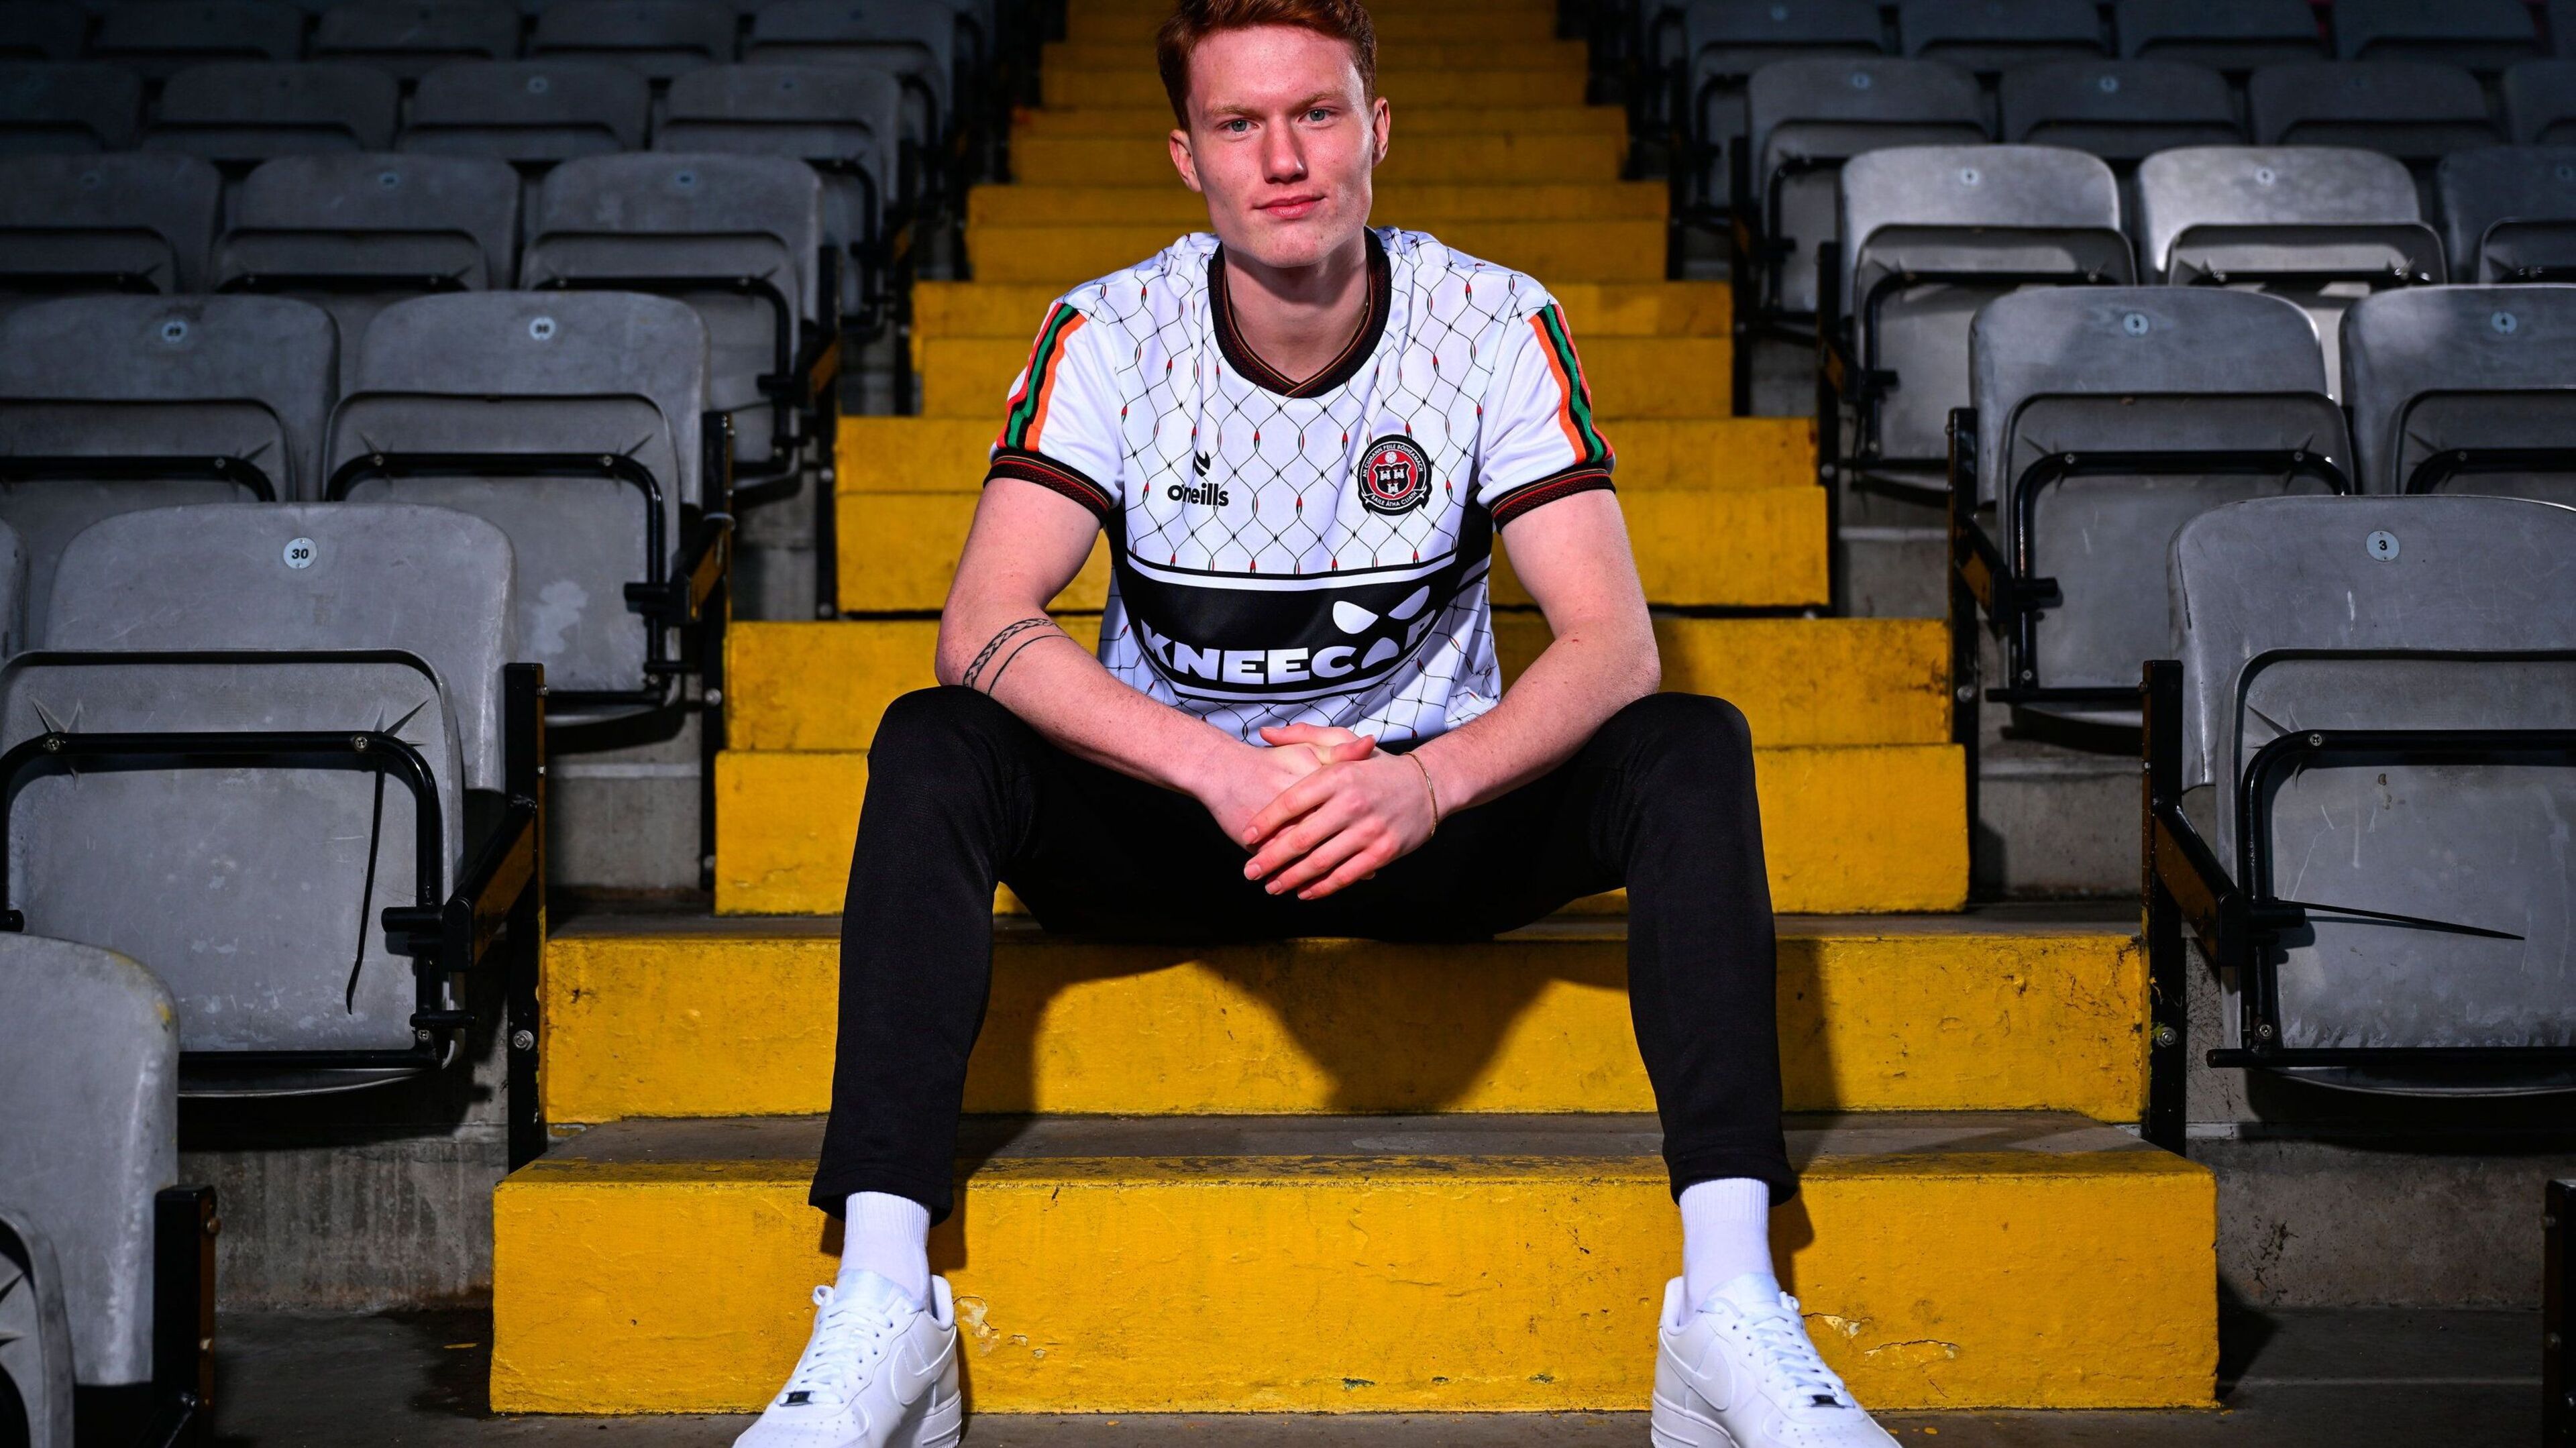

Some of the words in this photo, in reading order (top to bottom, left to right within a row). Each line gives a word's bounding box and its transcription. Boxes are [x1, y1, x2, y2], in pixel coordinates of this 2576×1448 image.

[1364, 447, 1383, 468] CUMANN
[1362, 469, 1368, 478] AN
[1371, 494, 1385, 506] BAILE
[1401, 490, 1417, 505] CLIATH
[2379, 539, 2388, 551] 3
[292, 549, 309, 559] 30
